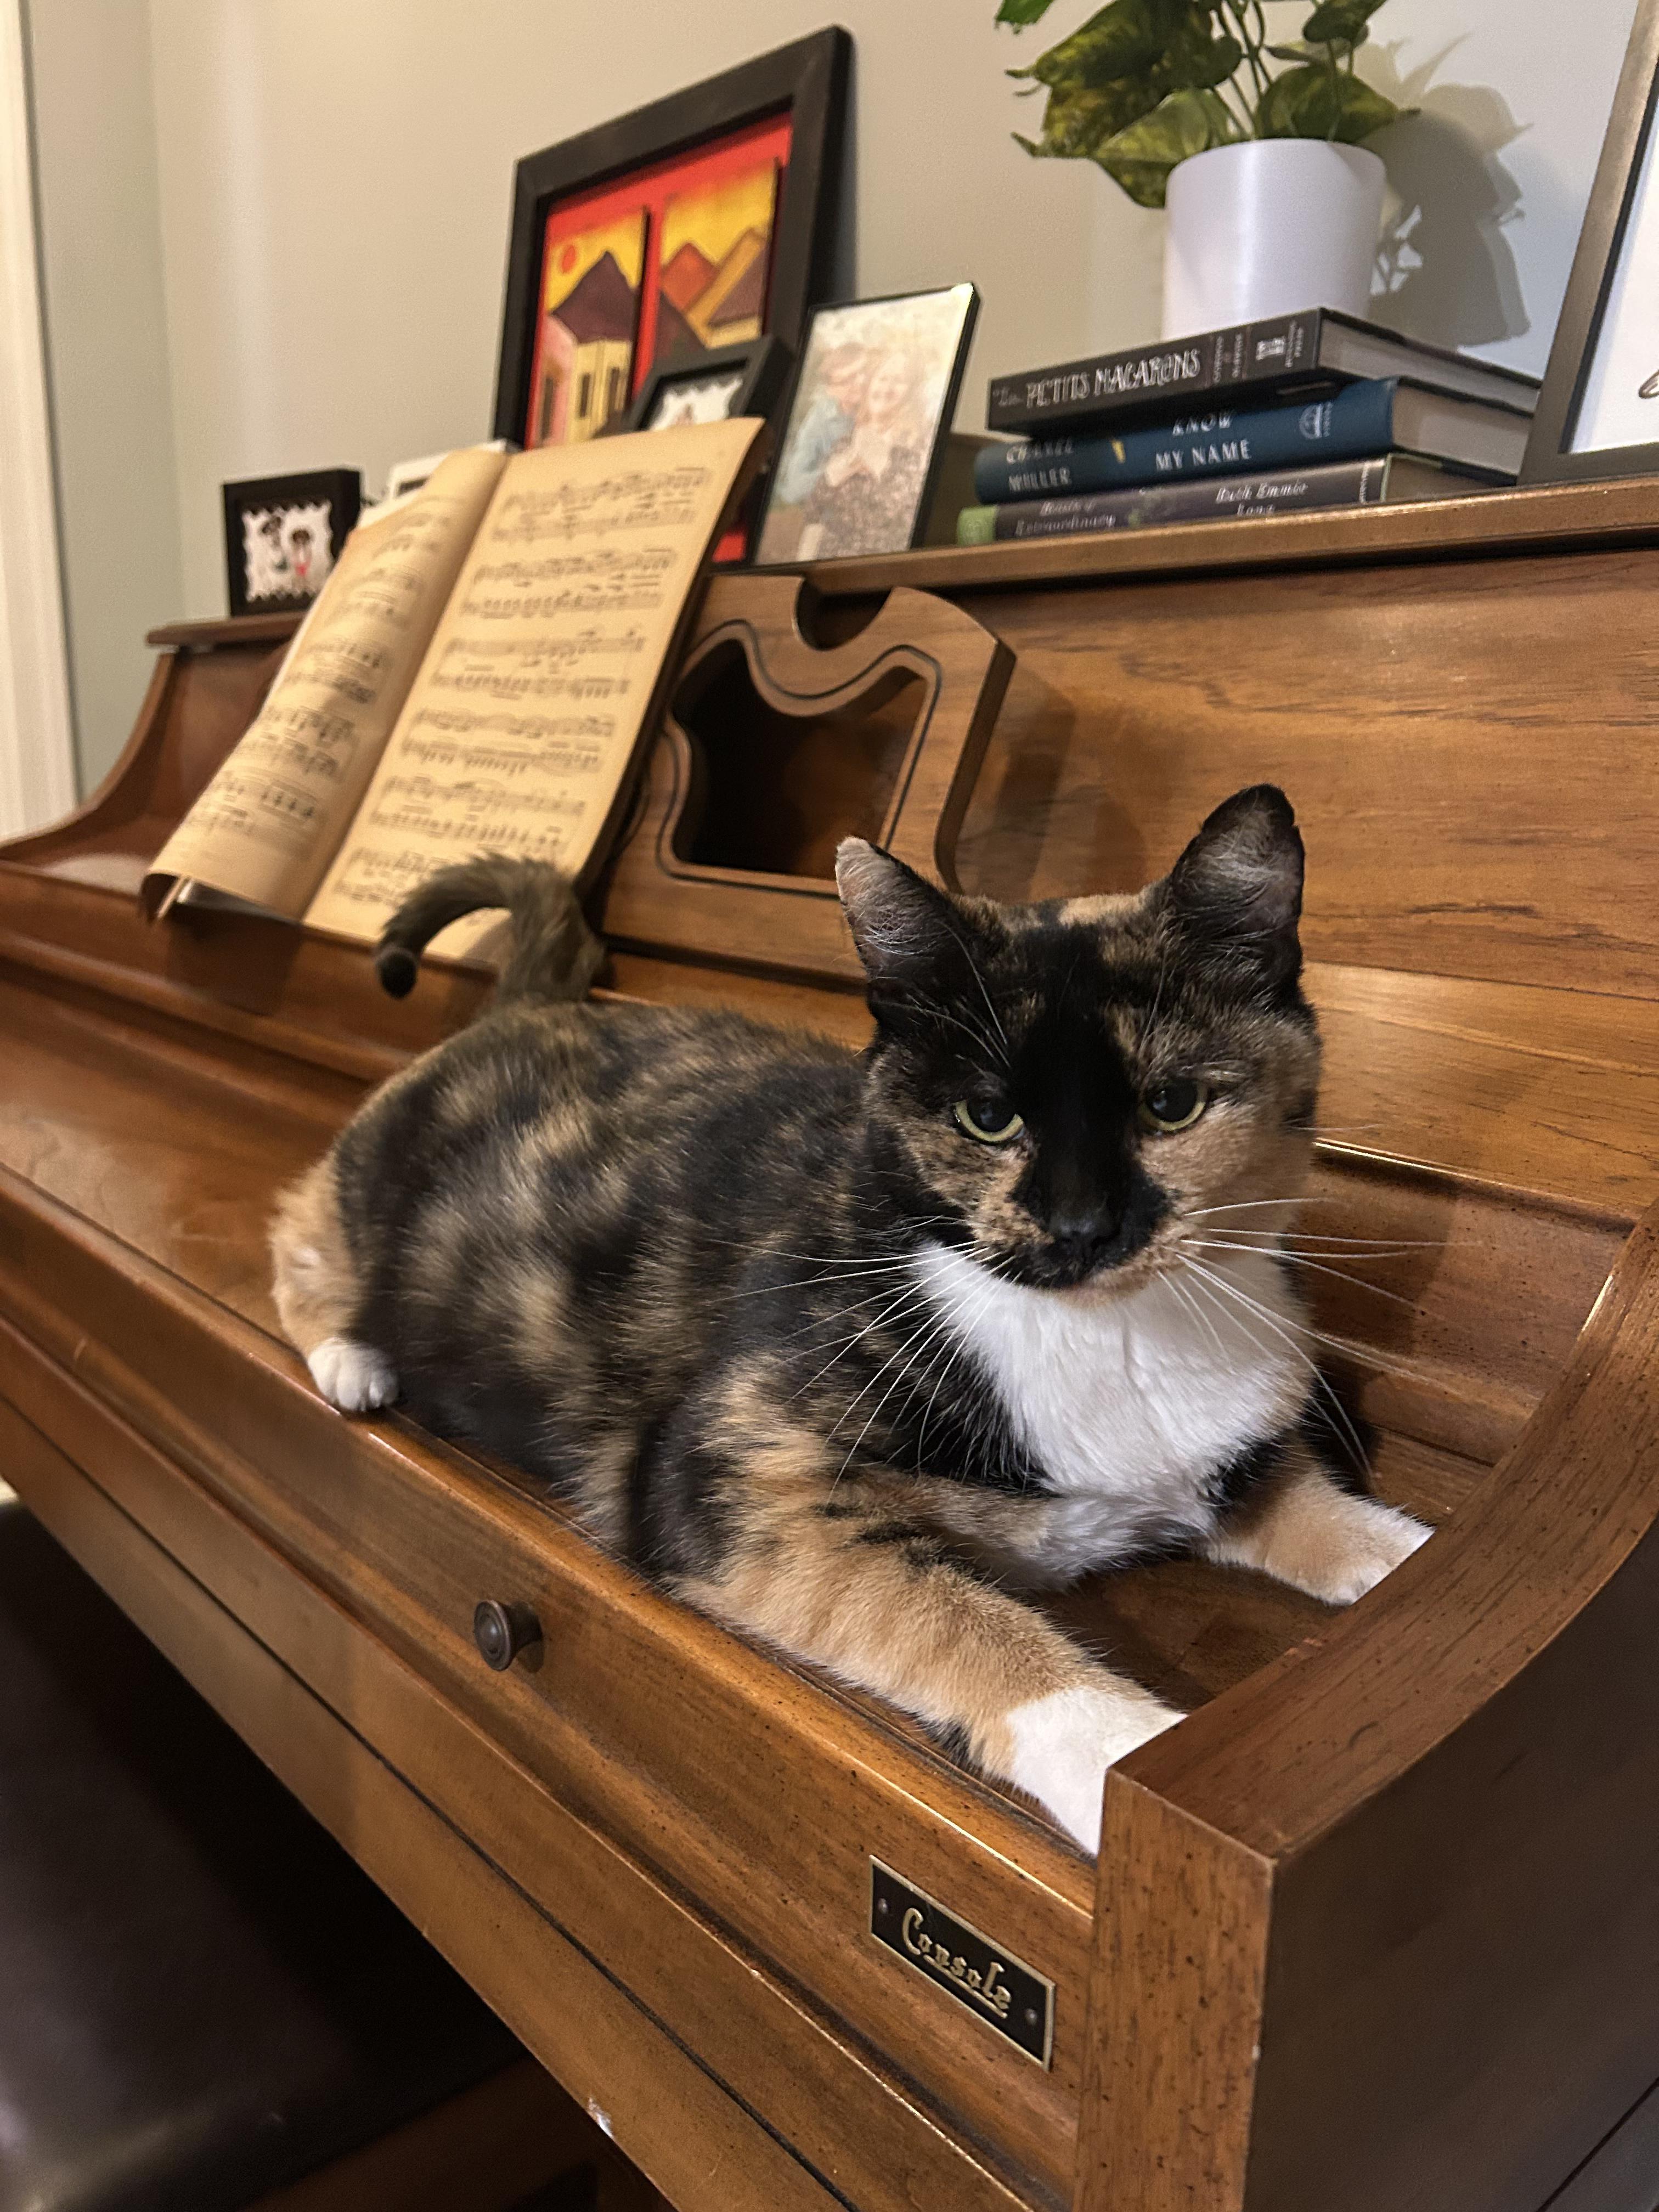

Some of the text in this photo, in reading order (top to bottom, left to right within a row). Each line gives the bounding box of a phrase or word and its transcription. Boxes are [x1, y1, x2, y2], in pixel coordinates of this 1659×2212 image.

[1026, 372, 1090, 409] PETITS
[1093, 348, 1201, 397] MACARONS
[1155, 438, 1252, 471] MY NAME
[902, 1907, 1012, 2012] Console
